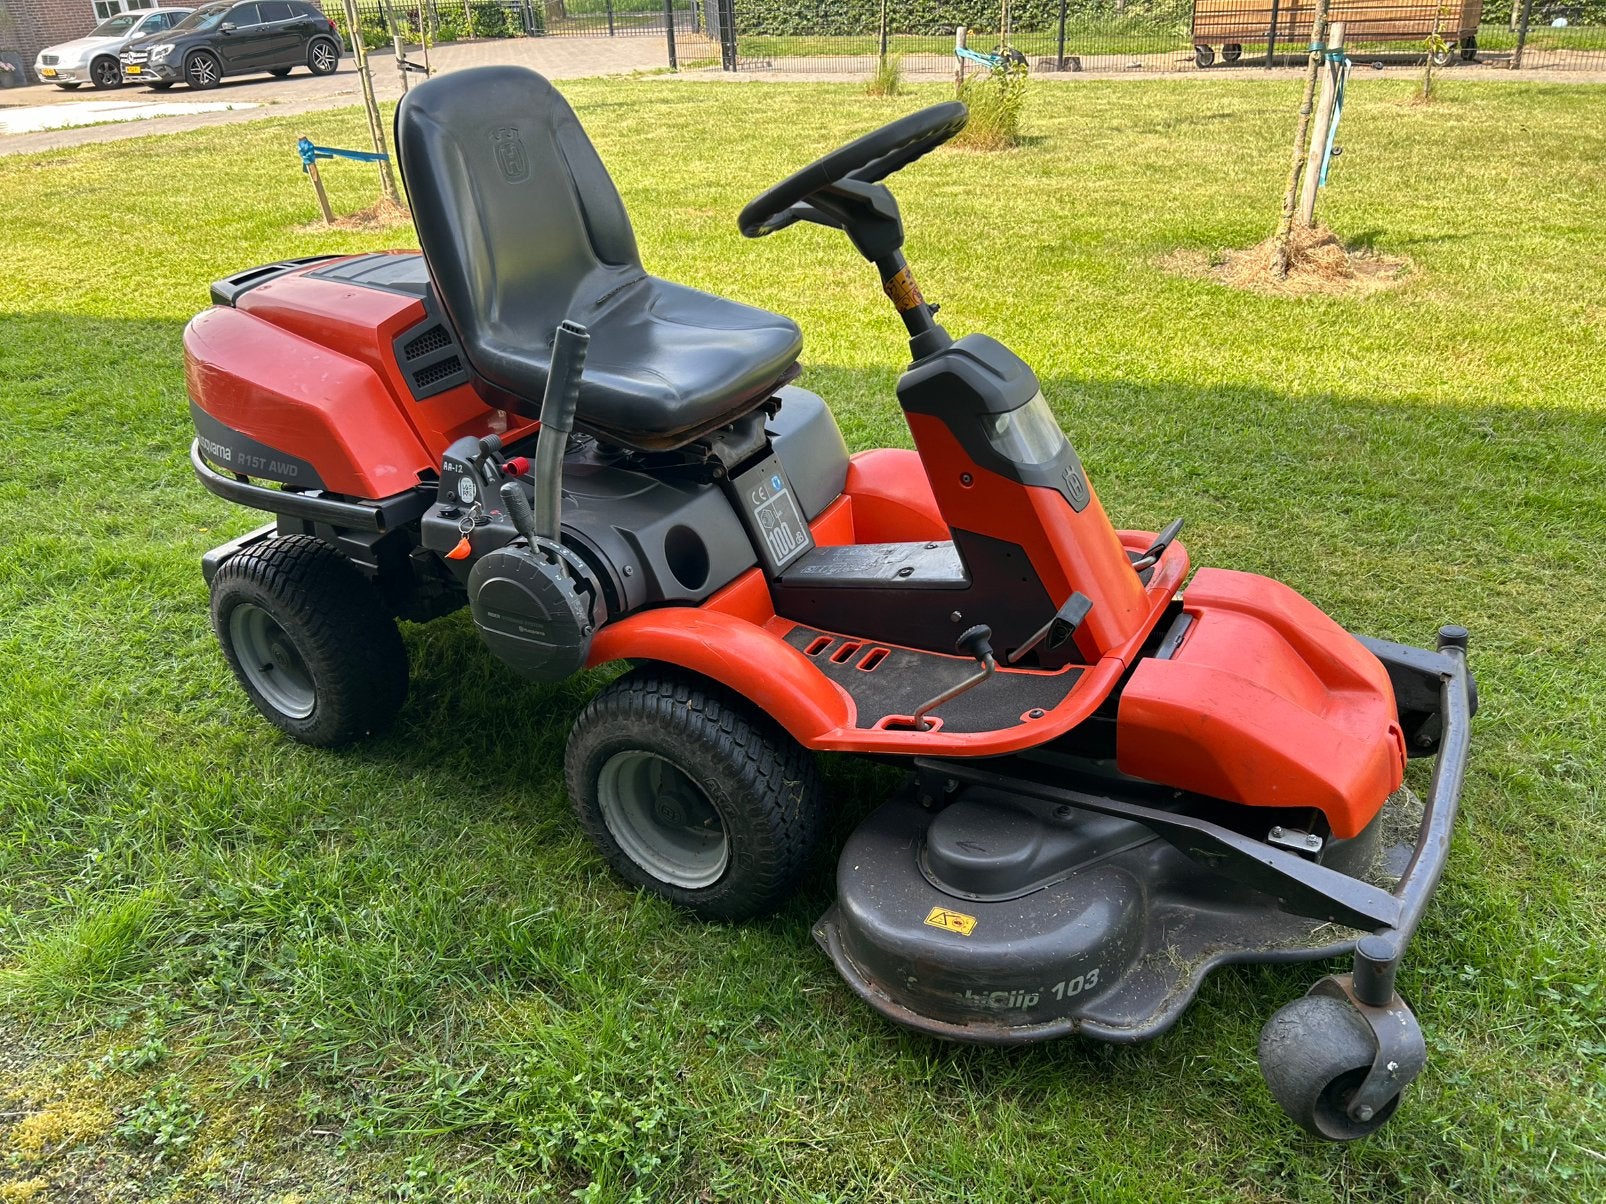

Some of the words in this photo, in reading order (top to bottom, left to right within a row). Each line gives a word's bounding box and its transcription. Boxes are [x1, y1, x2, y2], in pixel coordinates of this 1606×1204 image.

[238, 452, 266, 470] R15T
[268, 461, 298, 477] AWD
[751, 486, 767, 505] CE
[769, 521, 796, 559] 100
[1051, 968, 1099, 1001] 103
